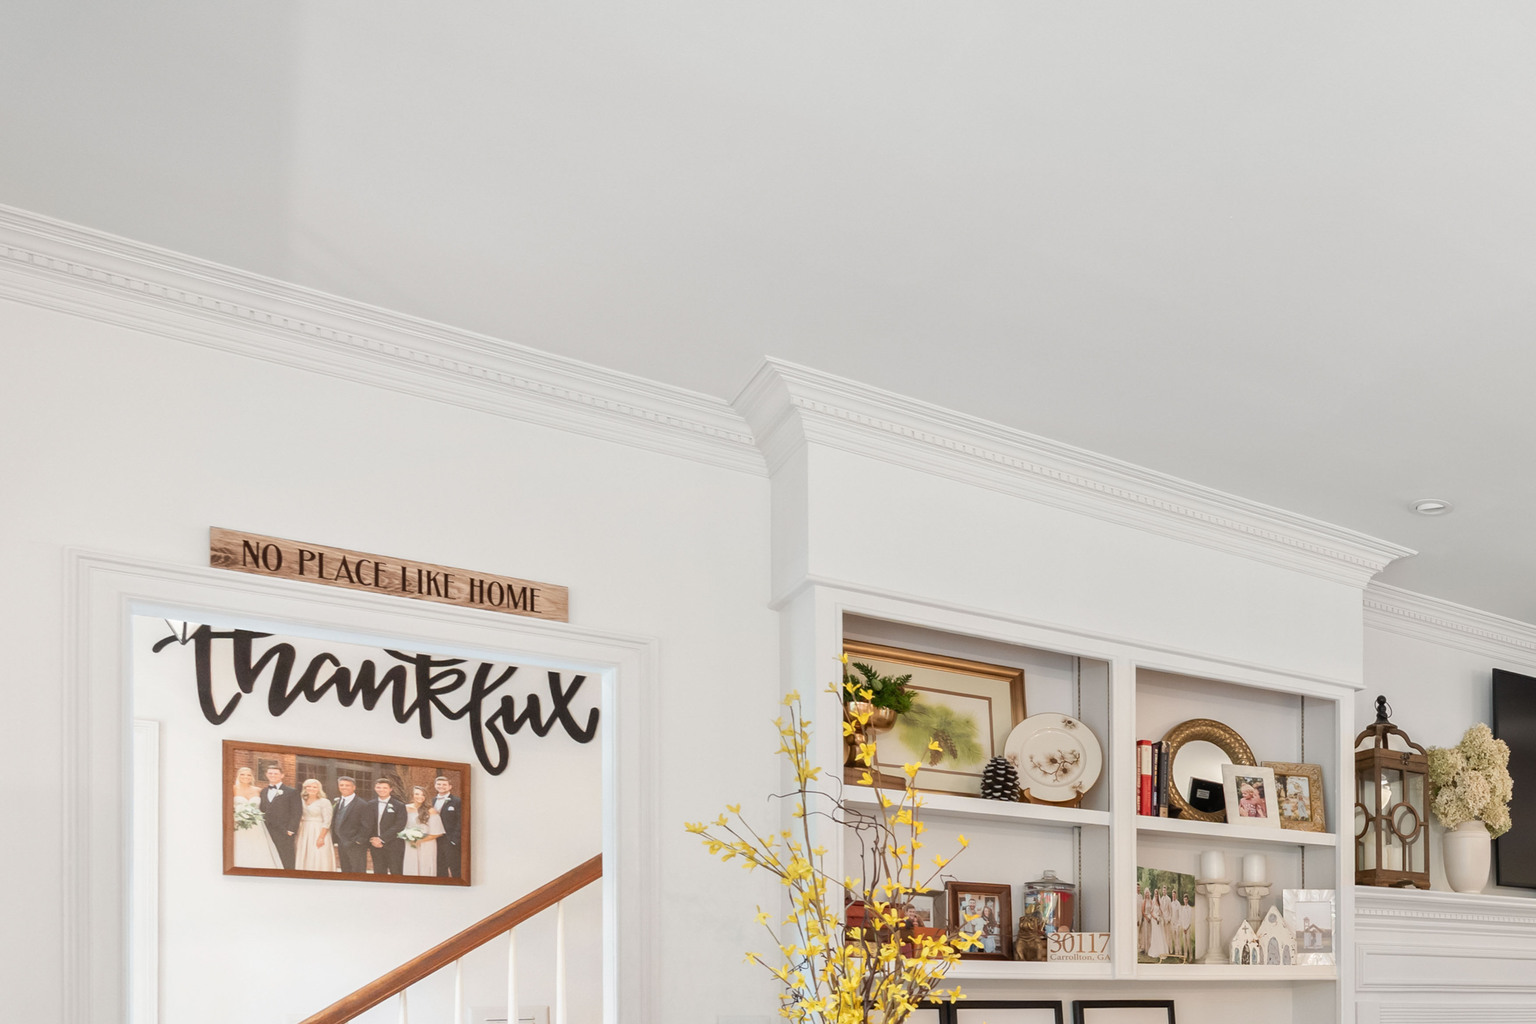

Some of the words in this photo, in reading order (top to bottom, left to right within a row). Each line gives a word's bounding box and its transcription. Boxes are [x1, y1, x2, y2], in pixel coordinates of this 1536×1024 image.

[242, 540, 283, 572] NO
[298, 549, 387, 589] PLACE
[401, 566, 456, 601] LIKE
[469, 578, 542, 614] HOME
[1050, 933, 1111, 953] 30117
